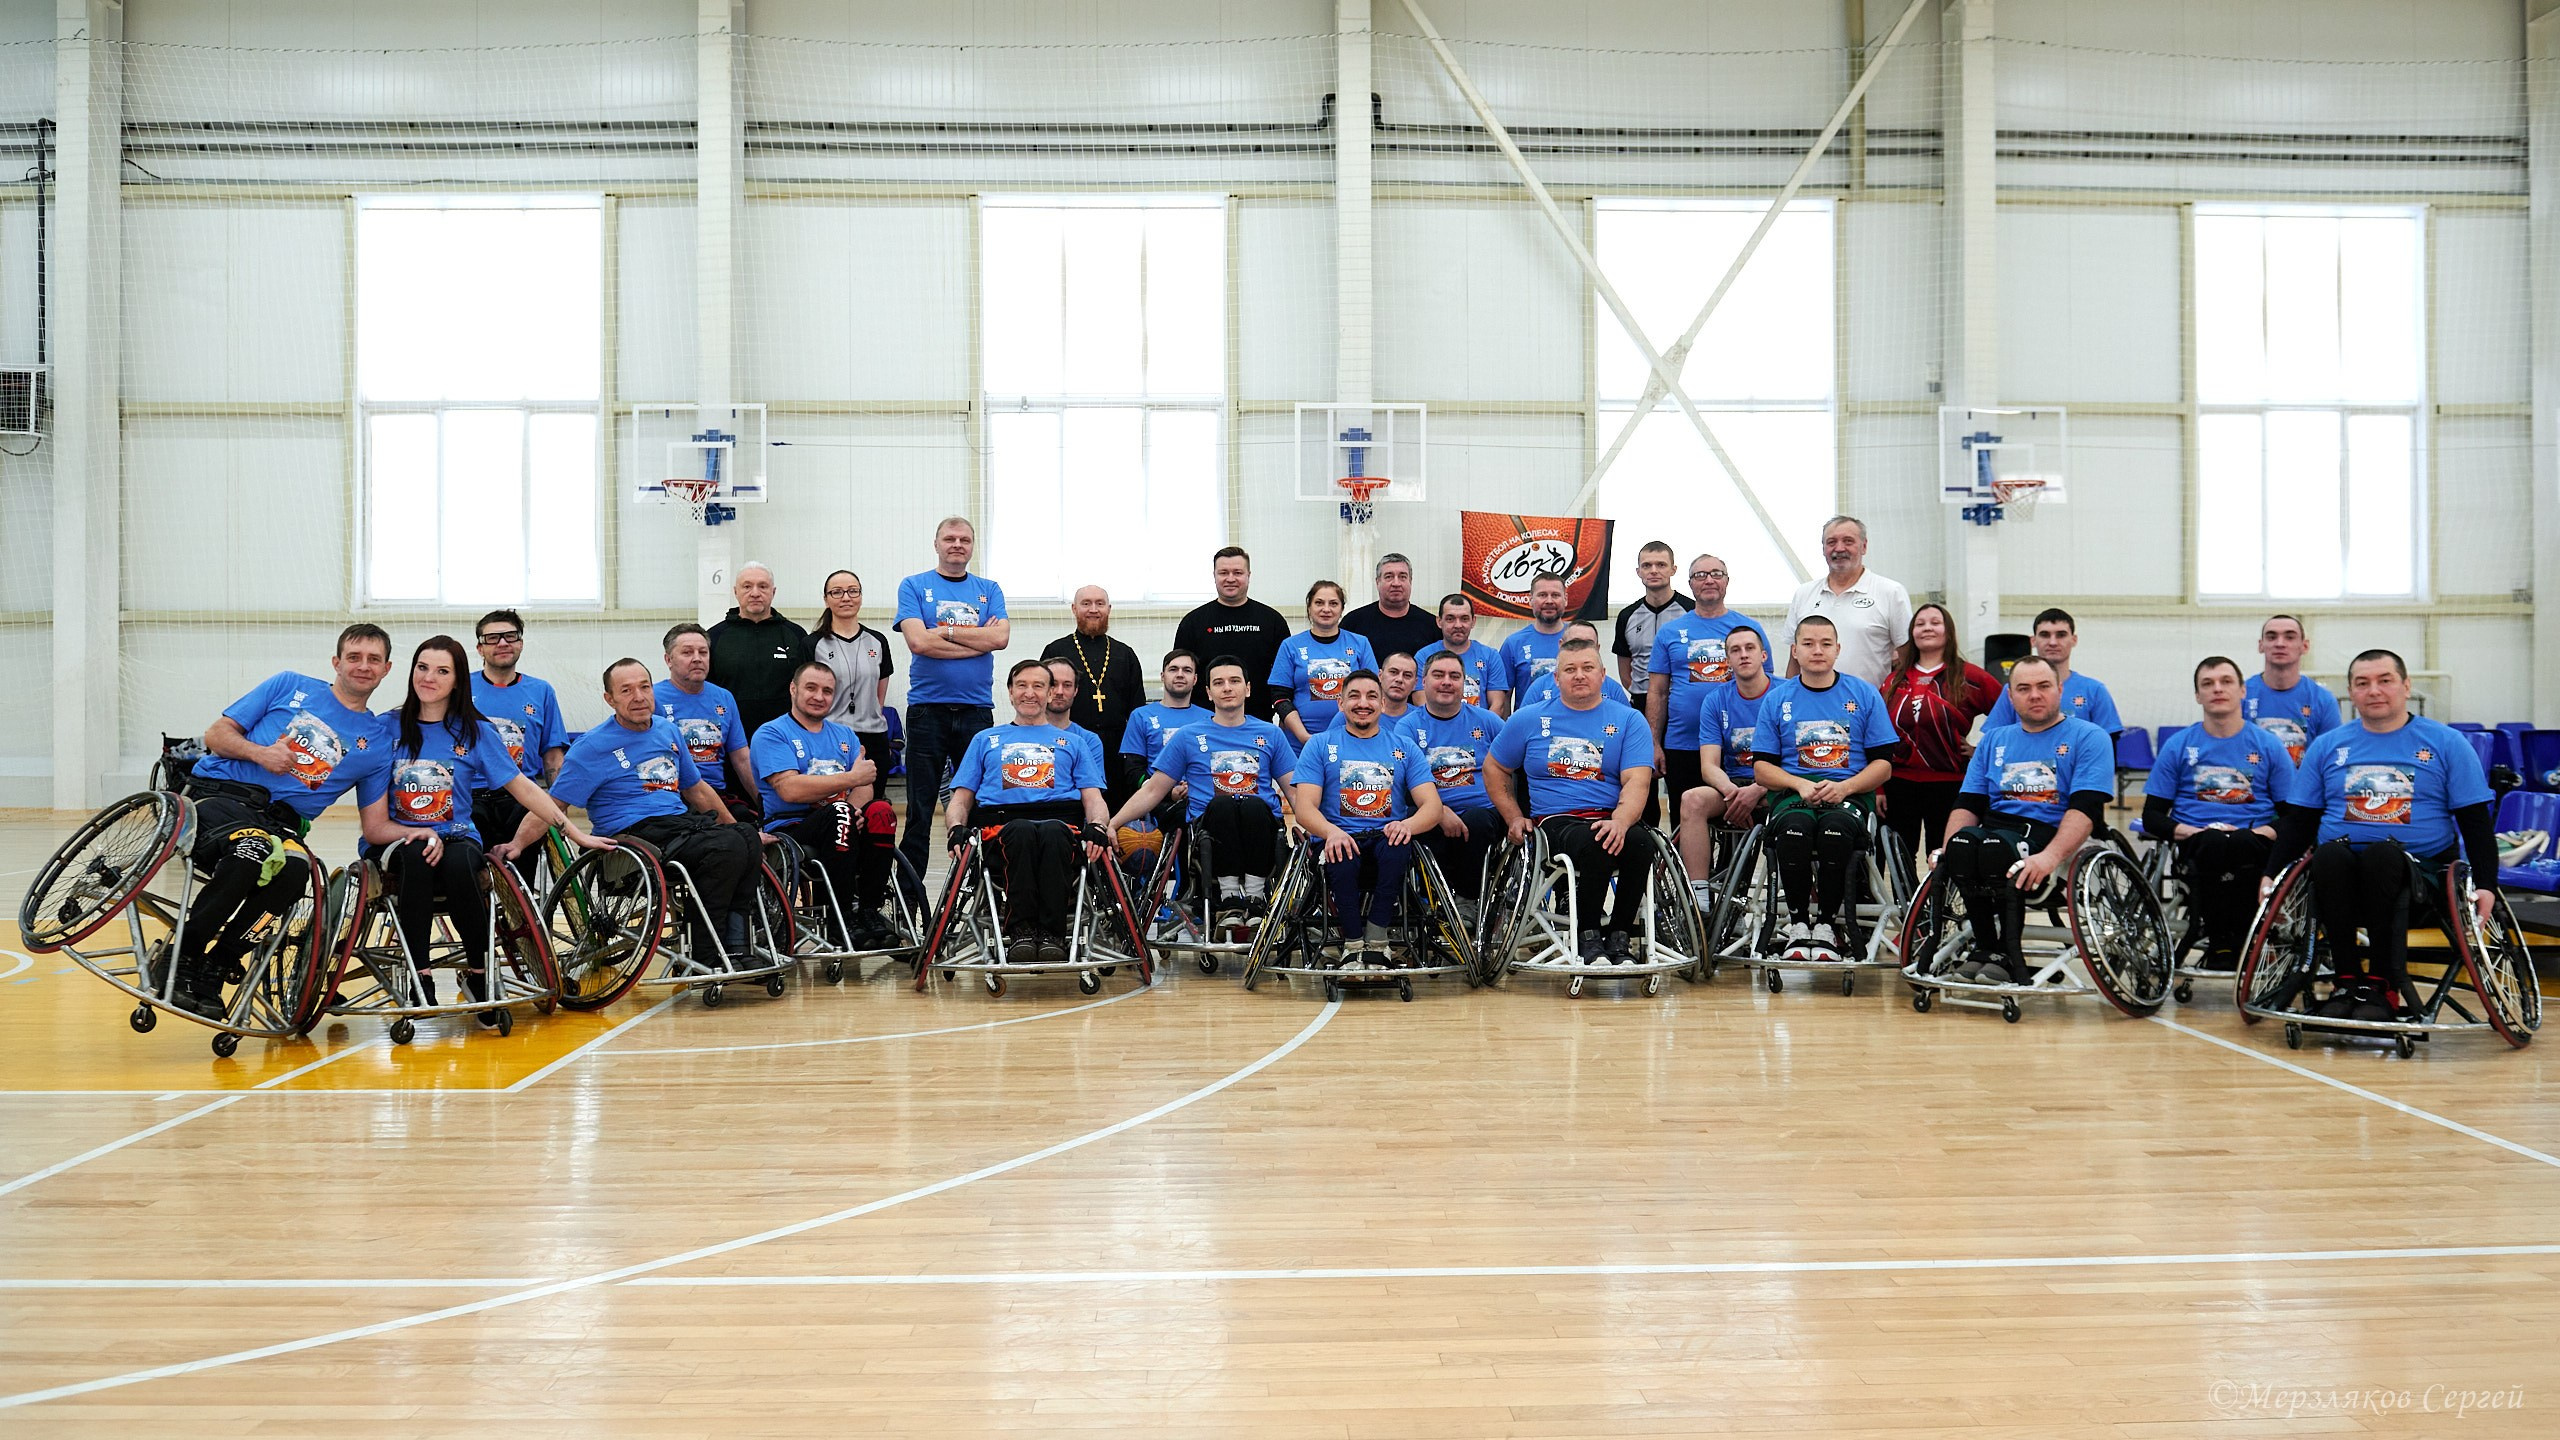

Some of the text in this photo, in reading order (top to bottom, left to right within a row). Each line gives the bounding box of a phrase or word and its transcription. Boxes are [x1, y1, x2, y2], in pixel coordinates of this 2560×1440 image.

[1482, 529, 1559, 585] БАСКЕТБОЛ НА КОЛЕСАХ
[712, 569, 723, 584] 6
[1497, 591, 1530, 604] ЛОКОМО
[1978, 602, 1988, 616] 5
[1697, 656, 1708, 664] 10
[1317, 672, 1327, 680] 10
[294, 734, 309, 748] 10
[306, 744, 327, 761] лет
[689, 738, 699, 746] 10
[1013, 757, 1025, 766] 10
[1559, 756, 1591, 768] 10 лет
[404, 782, 440, 793] 10 лет
[1351, 781, 1364, 791] 10
[2012, 783, 2046, 793] 10 лет
